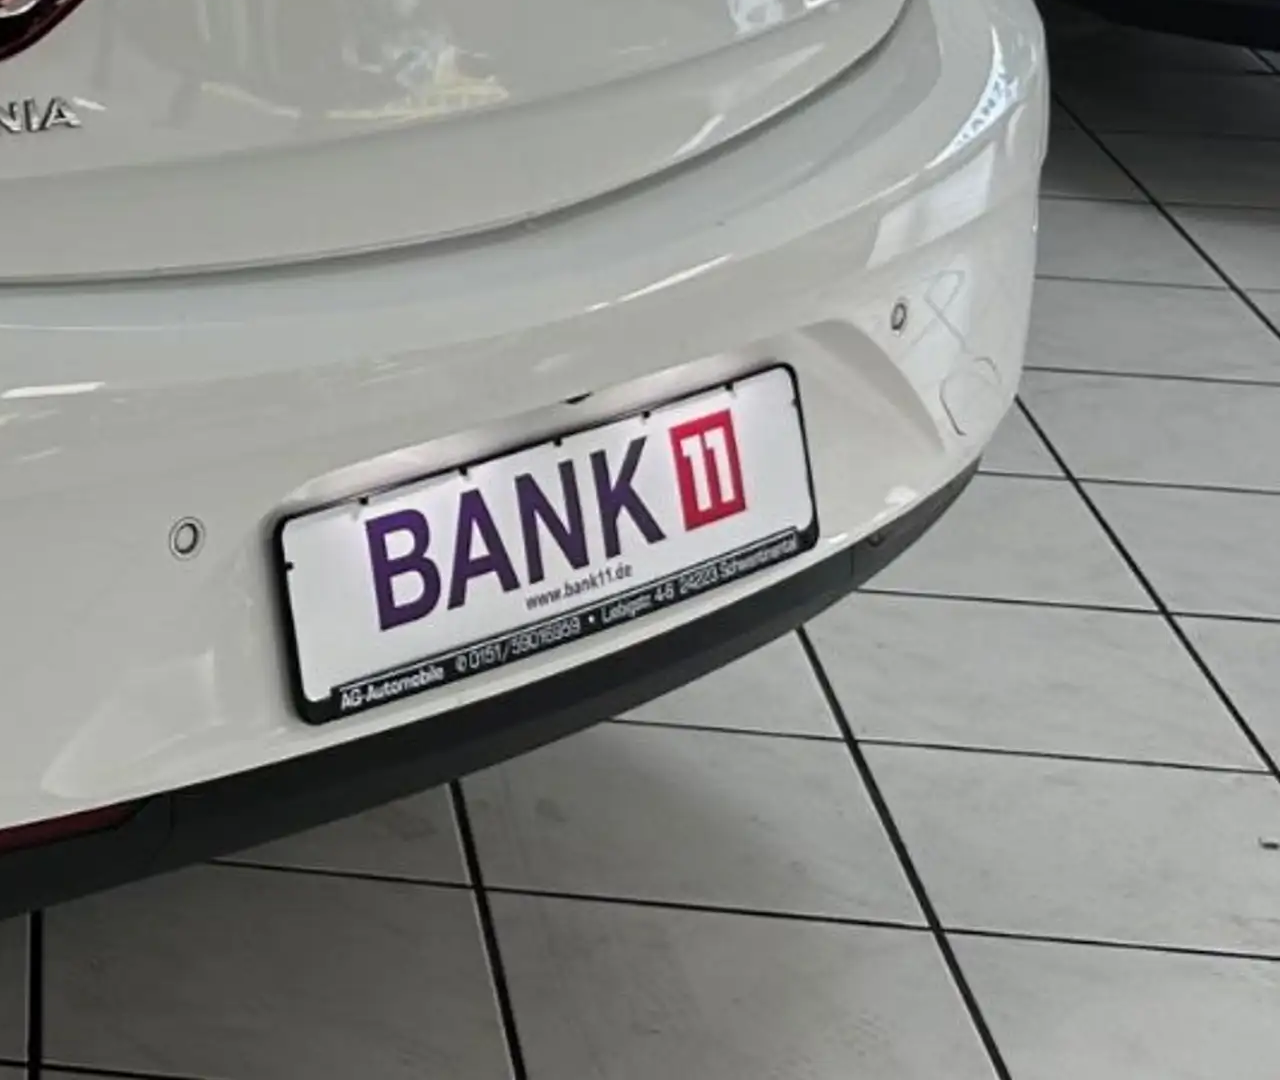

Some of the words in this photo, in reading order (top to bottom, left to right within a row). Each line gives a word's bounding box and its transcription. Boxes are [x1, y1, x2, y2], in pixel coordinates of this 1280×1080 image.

[366, 436, 666, 631] BANK
[678, 423, 737, 516] 11
[525, 562, 634, 610] www.bank11.de
[340, 665, 445, 711] AG-Automobile
